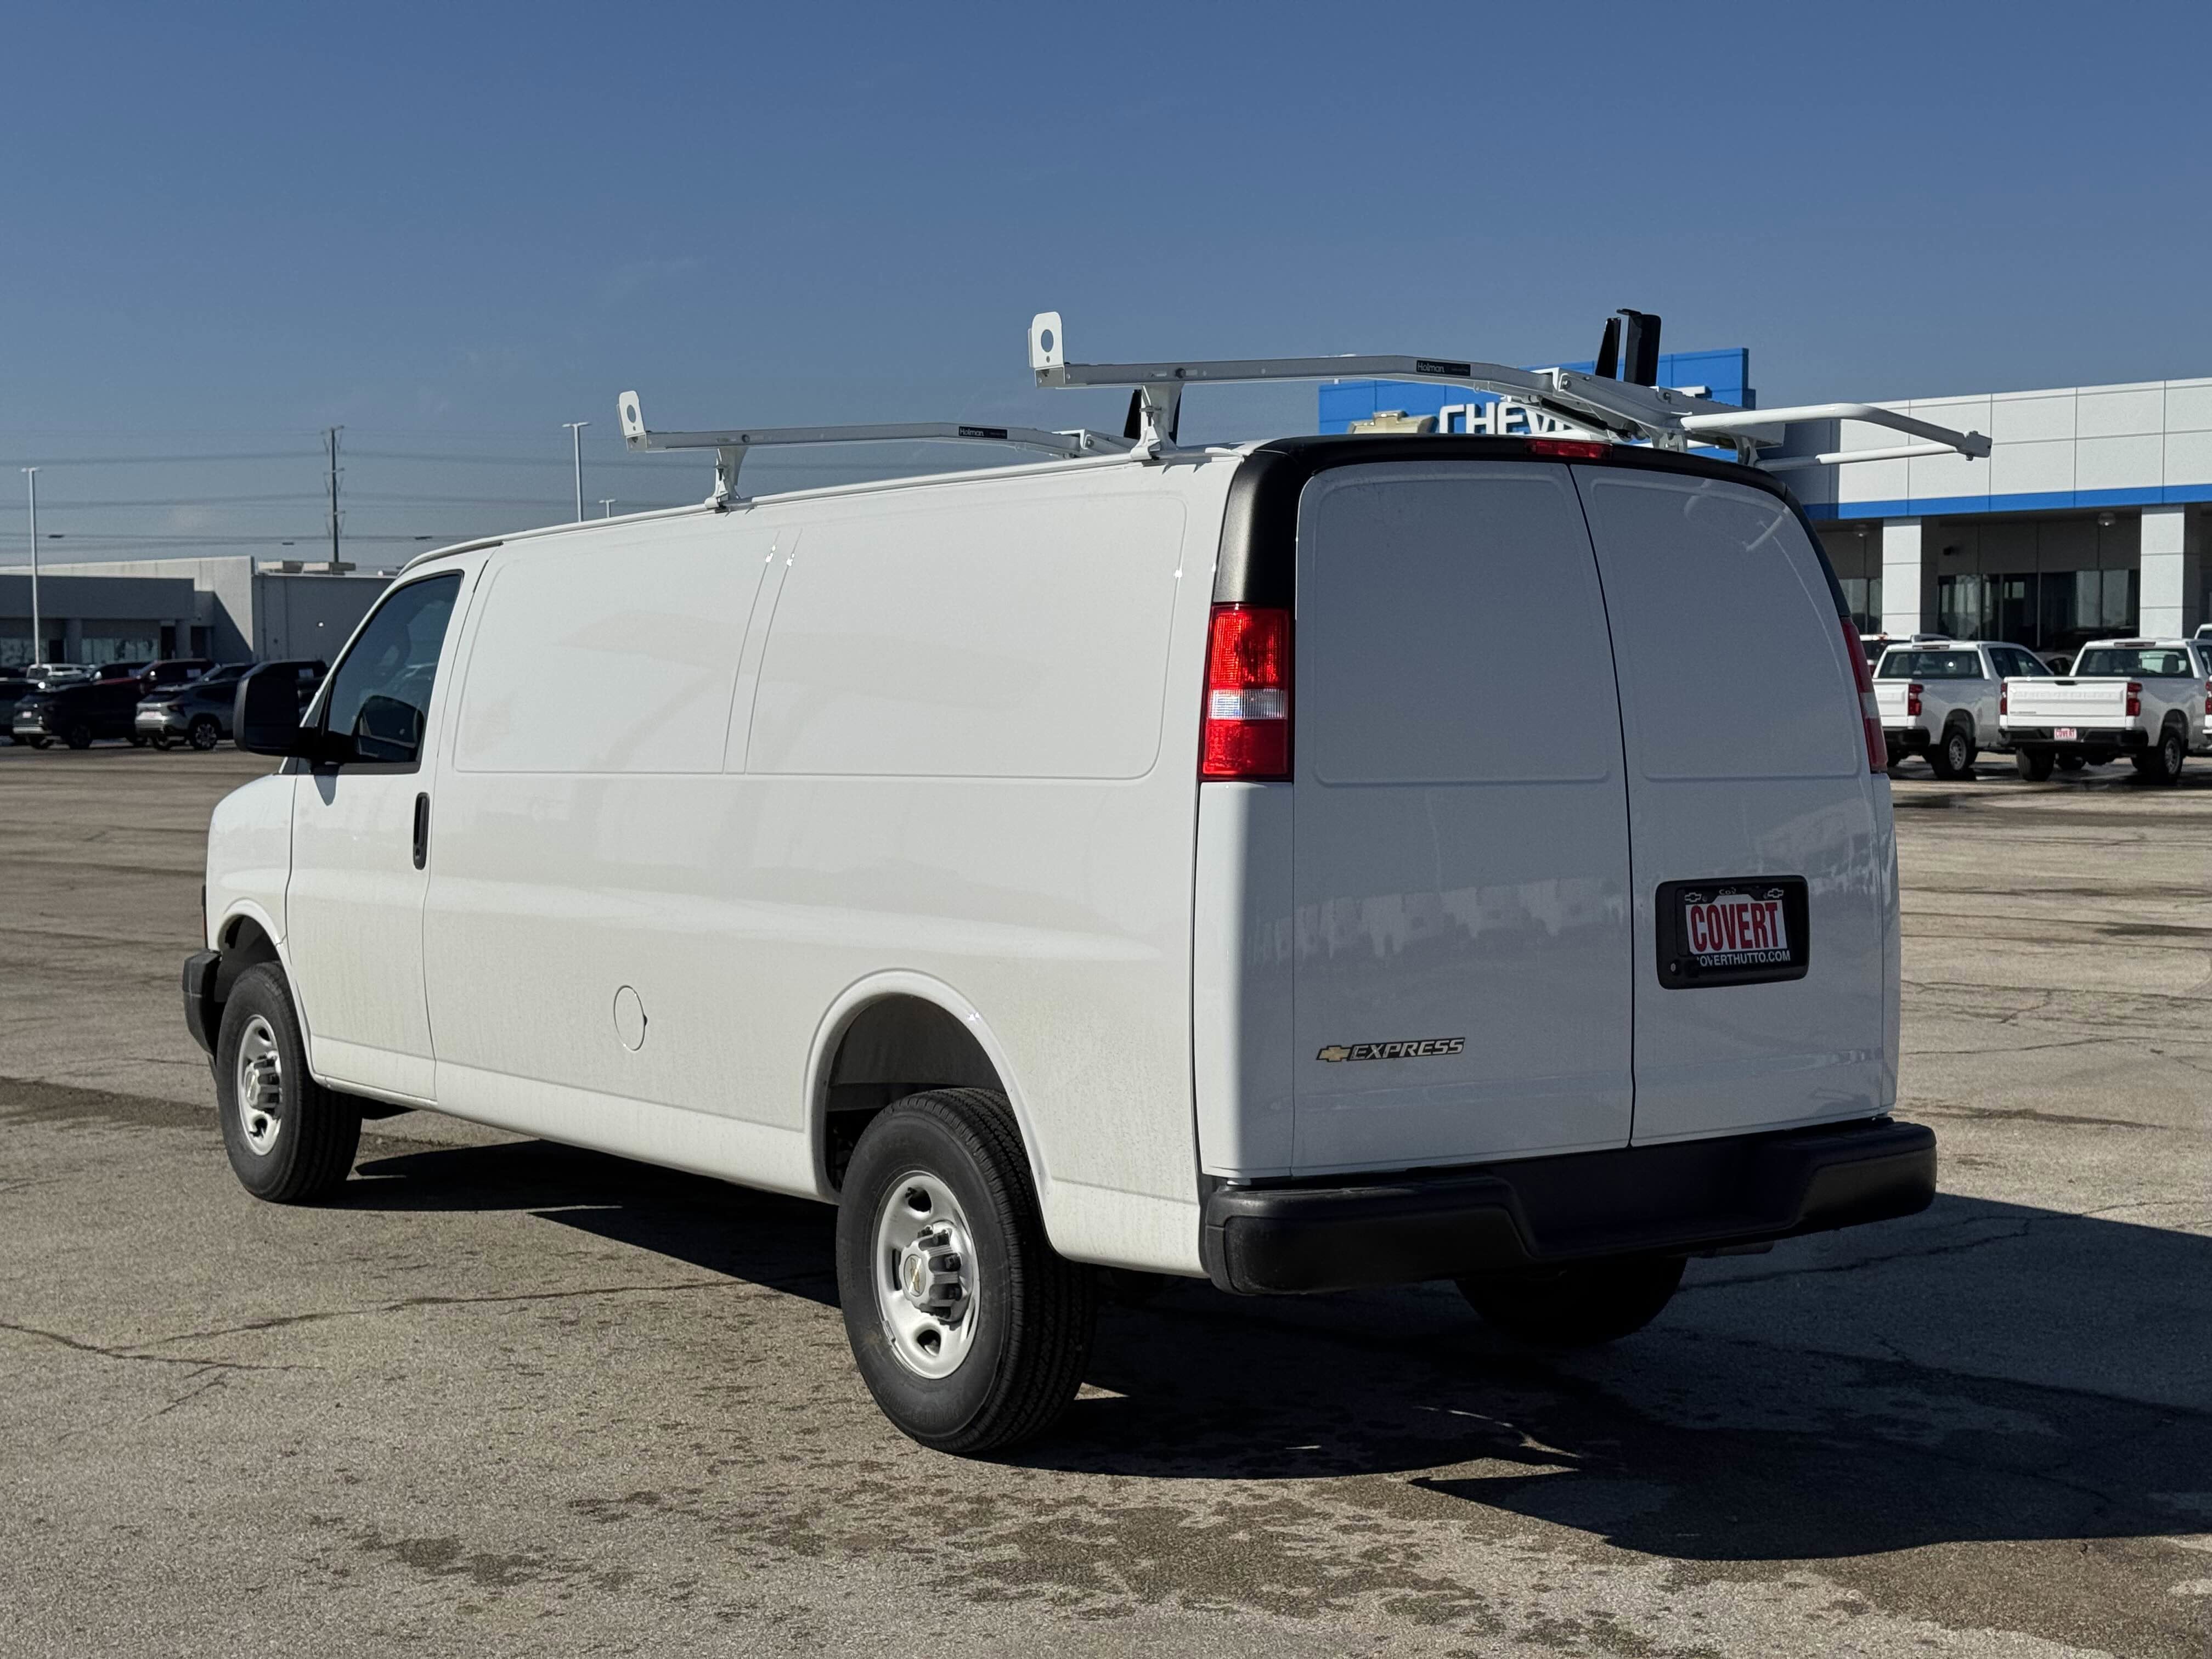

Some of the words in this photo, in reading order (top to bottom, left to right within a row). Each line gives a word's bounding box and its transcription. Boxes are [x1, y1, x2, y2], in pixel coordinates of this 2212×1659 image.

[1439, 402, 1565, 435] CHEV
[1691, 902, 1779, 952] COVERT
[1696, 951, 1790, 967] OVERTHUTTO.COM
[1349, 1039, 1464, 1060] EXPRESS
